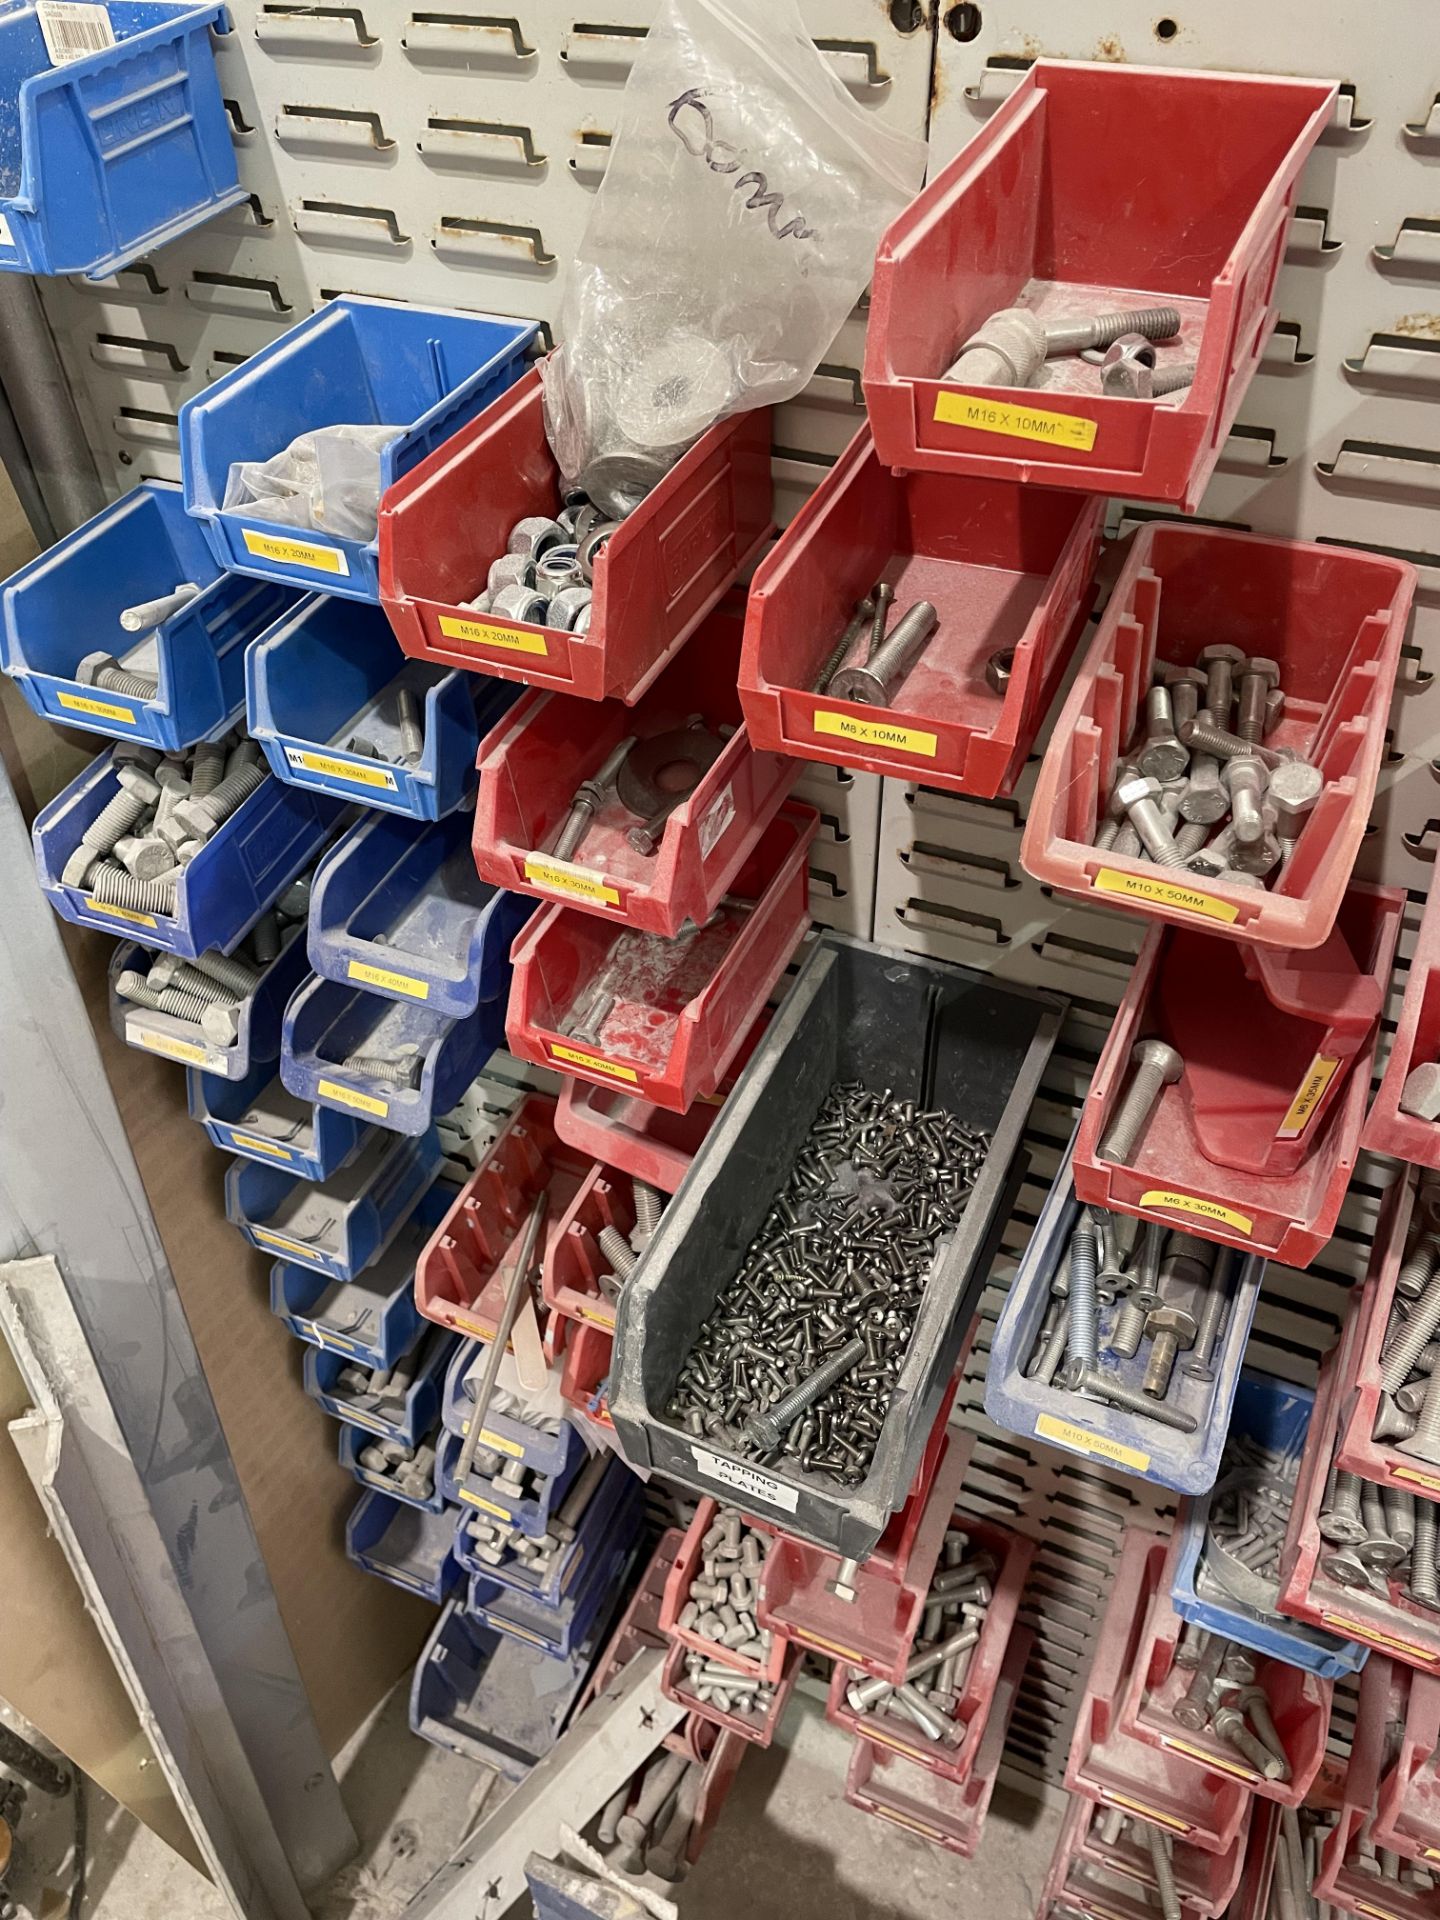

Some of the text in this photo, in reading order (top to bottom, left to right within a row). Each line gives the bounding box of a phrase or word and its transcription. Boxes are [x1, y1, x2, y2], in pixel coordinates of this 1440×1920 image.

[967, 407, 1057, 436] M16 X 10MM
[263, 543, 316, 561] M16 X 20MM
[461, 625, 520, 645] M16 X 20MM
[840, 721, 908, 744] M8 X 10MM
[543, 871, 561, 883] M16
[570, 880, 596, 893] 30MM
[1125, 880, 1205, 907] M10 X 50MM
[364, 970, 380, 982] M16
[567, 1052, 584, 1062] M16
[593, 1060, 616, 1073] 40MM
[1295, 1075, 1324, 1116] M6 X 35MM
[1164, 1196, 1227, 1219] M6 X 30MM
[1062, 1428, 1083, 1442] M10
[1085, 1436, 1093, 1445] X
[712, 1456, 779, 1491] TAPPING
[718, 1471, 777, 1501] PLATES
